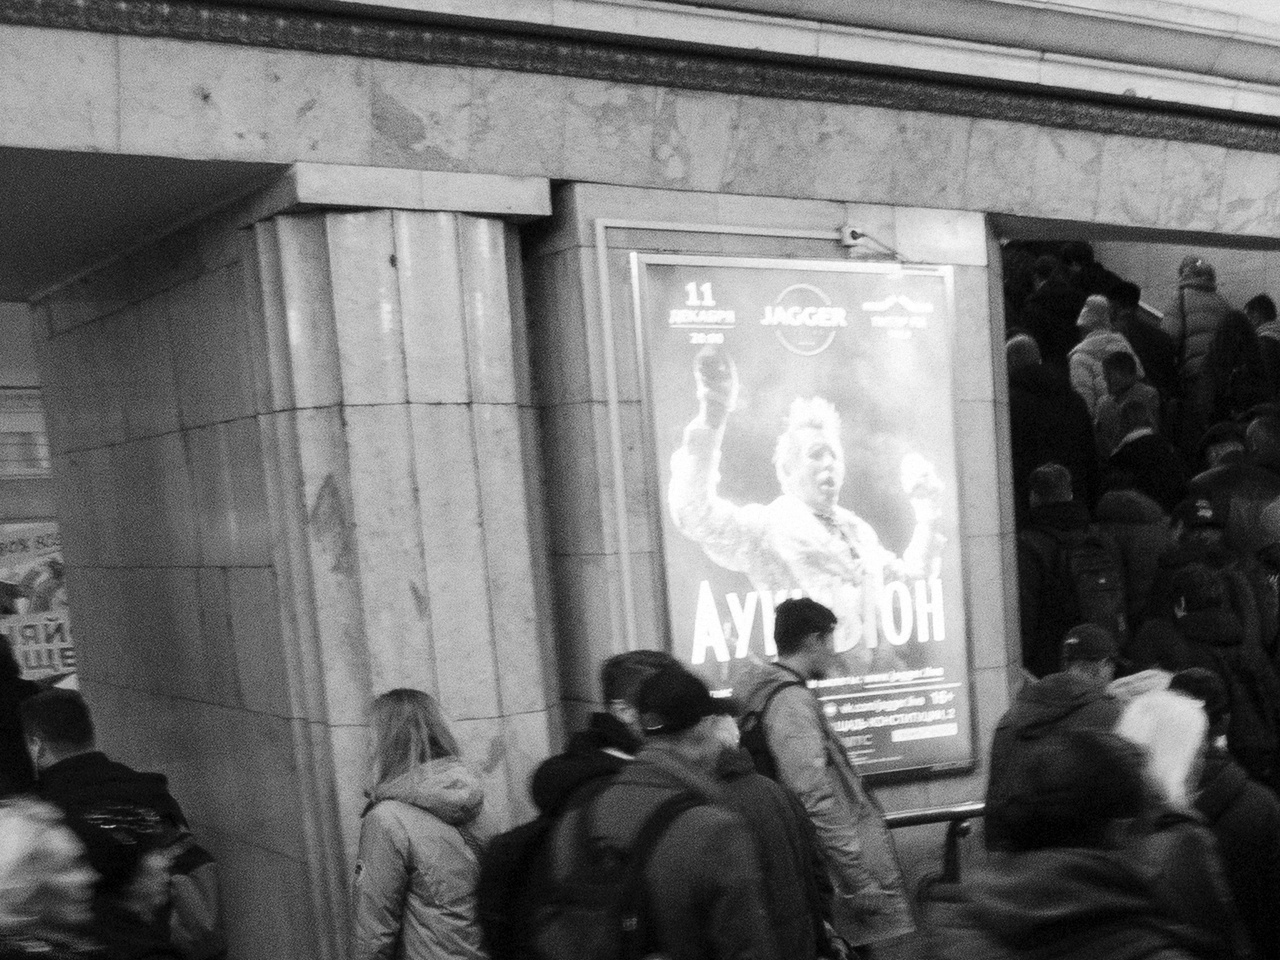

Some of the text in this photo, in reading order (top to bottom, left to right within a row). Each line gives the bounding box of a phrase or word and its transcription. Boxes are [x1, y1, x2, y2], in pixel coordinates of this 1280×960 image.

[684, 281, 716, 306] 11
[760, 305, 849, 327] JAGGER
[691, 578, 945, 665] АУЫОН
